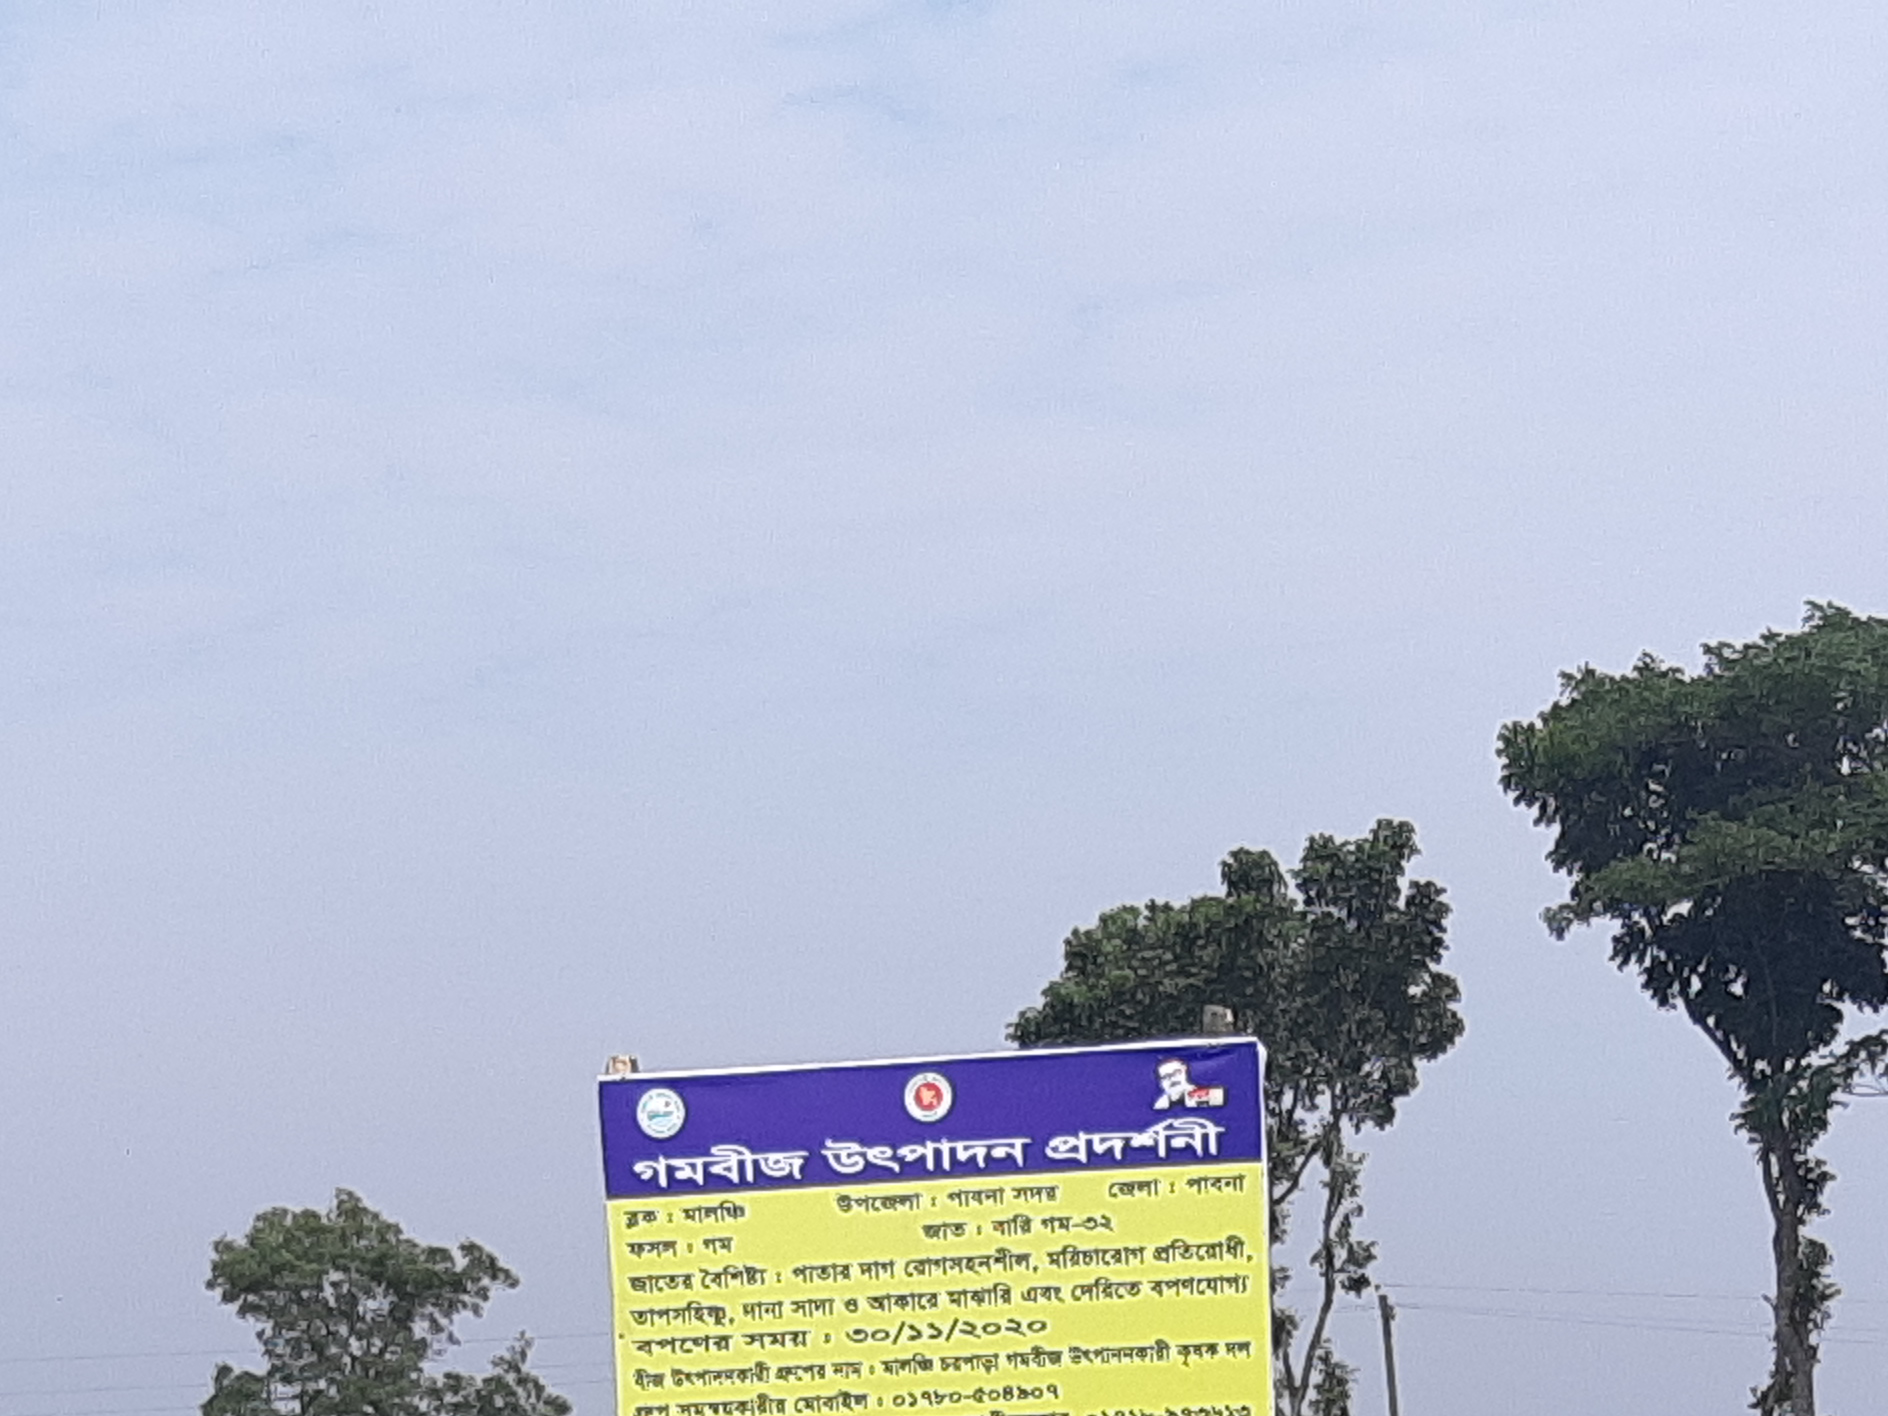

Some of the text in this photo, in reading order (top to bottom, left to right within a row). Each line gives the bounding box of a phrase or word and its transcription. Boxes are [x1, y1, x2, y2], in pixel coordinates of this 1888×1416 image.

[632, 1117, 1226, 1188] গমবীজ উৎপাদন প্রদর্শনী
[836, 1192, 921, 1213] উপজেলা
[947, 1187, 1005, 1208] পাবনা
[1012, 1184, 1060, 1203] সদর
[1108, 1178, 1159, 1198] জেলা
[1185, 1173, 1246, 1194] পাবনা
[624, 1209, 659, 1229] ব্লক
[922, 1221, 967, 1241] জাত
[991, 1213, 1032, 1236] বারি
[1040, 1214, 1114, 1234] গম-৩২
[626, 1240, 677, 1259] ফসল
[703, 1237, 733, 1254] গম
[628, 1272, 694, 1293] জাতের
[792, 1263, 851, 1284] পাতার
[858, 1260, 895, 1281] দাগ
[1048, 1245, 1146, 1269] মরিচারোগ
[742, 1300, 783, 1319] দানা
[791, 1298, 833, 1318] সাদা
[845, 1299, 858, 1314] ও
[867, 1291, 939, 1312] আকারে
[945, 1283, 1012, 1308] মাঝারি
[1020, 1284, 1064, 1304] এবং
[1070, 1277, 1143, 1302] দেরিতে
[742, 1330, 811, 1350] সময়
[845, 1318, 1048, 1345] ৩০/১১/২০২০
[832, 1362, 862, 1379] নাম
[794, 1389, 868, 1414] মোবাইল
